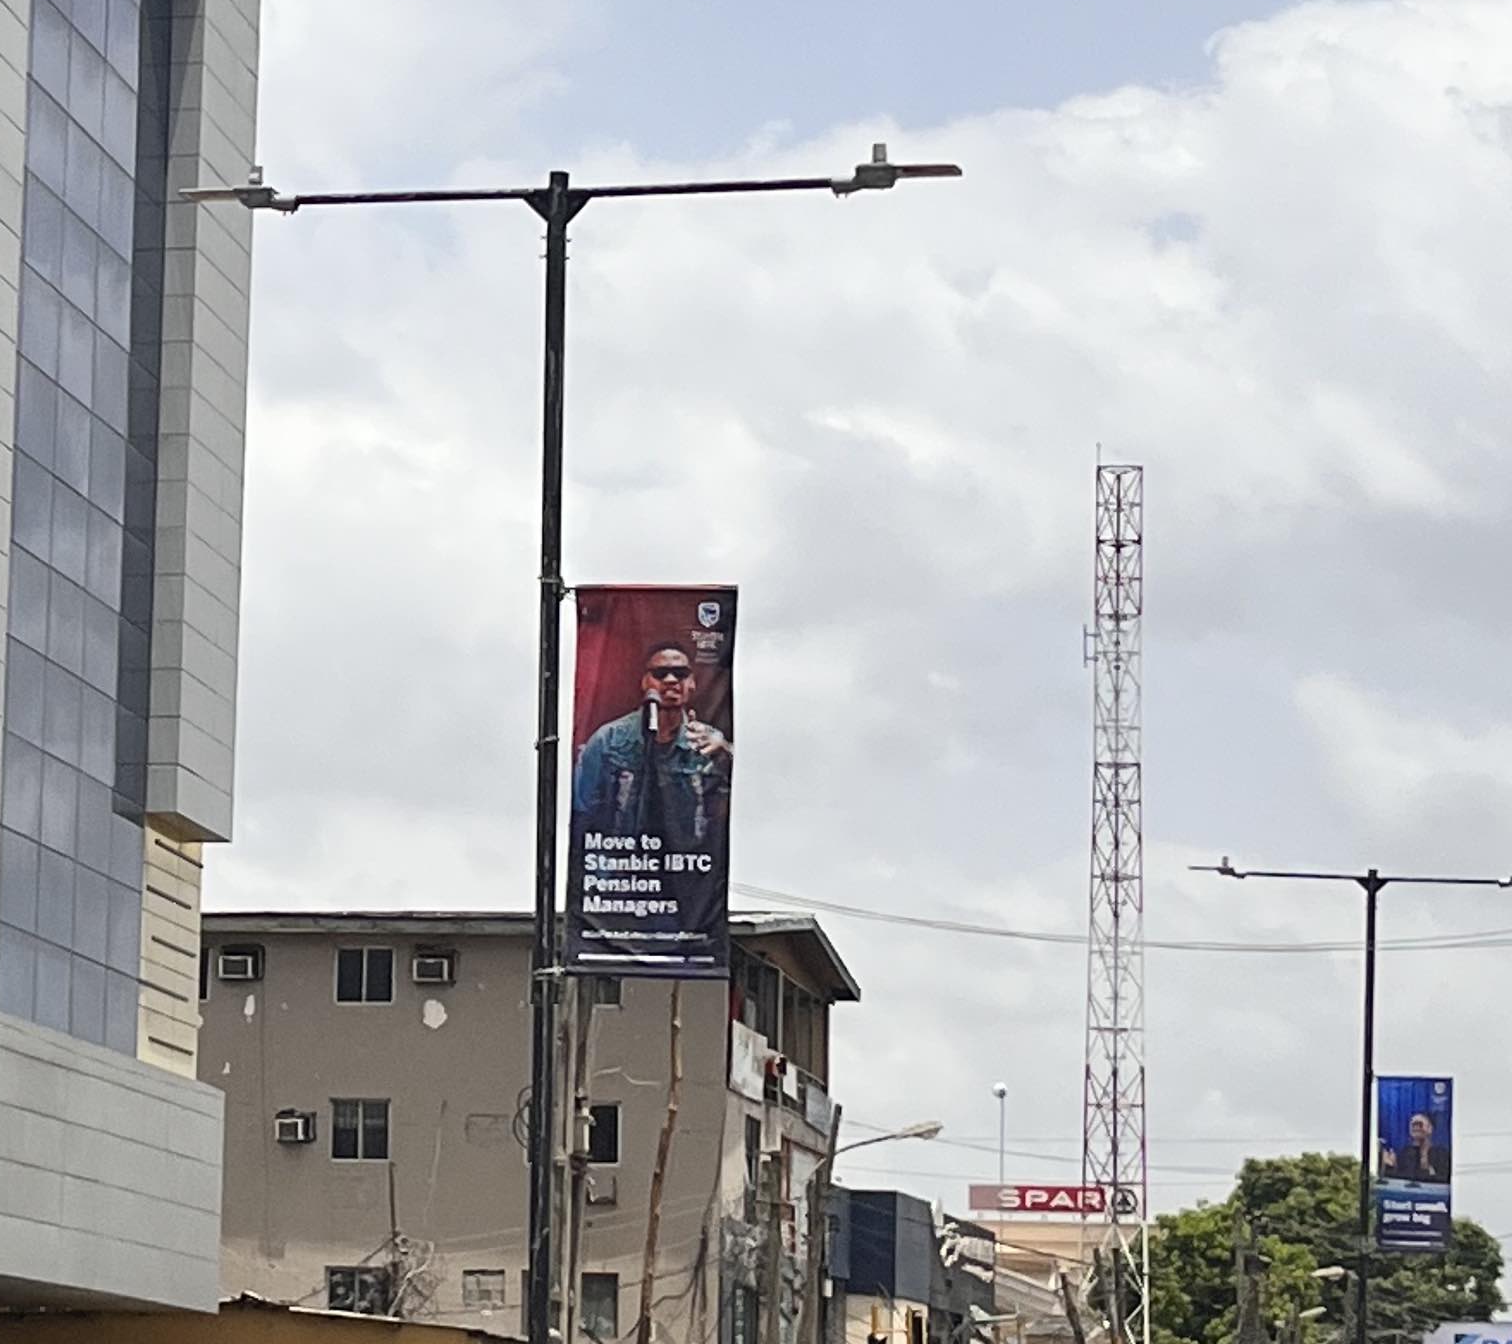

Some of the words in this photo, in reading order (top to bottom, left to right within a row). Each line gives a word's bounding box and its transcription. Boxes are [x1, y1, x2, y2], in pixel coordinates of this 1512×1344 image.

[584, 832, 636, 850] Move
[640, 833, 662, 850] to
[584, 853, 660, 871] Stanbic
[664, 853, 712, 872] IBTC
[583, 874, 661, 892] Pension
[582, 895, 679, 917] Managers
[997, 1188, 1102, 1210] SPAR
